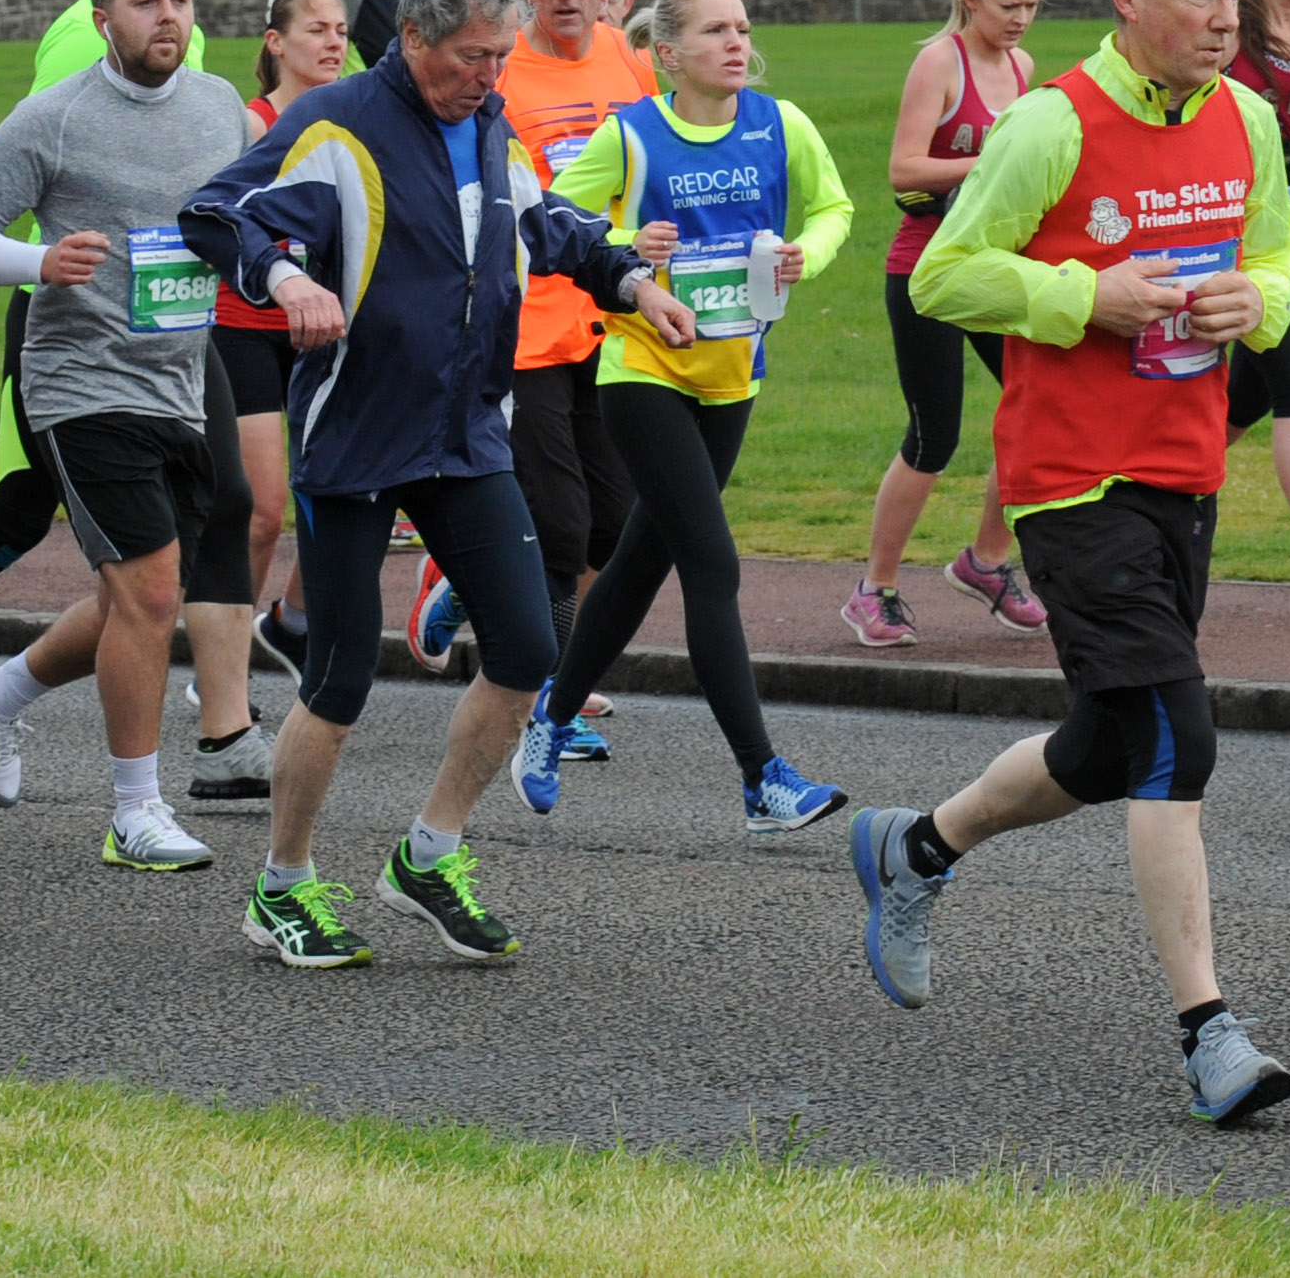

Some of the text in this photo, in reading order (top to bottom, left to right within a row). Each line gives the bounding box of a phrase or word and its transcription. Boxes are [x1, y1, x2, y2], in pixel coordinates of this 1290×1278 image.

[668, 166, 760, 196] REDCAR
[673, 188, 761, 209] RUNNING CLUB
[1135, 189, 1177, 211] The
[1179, 182, 1222, 206] Sick
[1137, 210, 1193, 229] Friends
[159, 234, 183, 243] mara
[700, 239, 745, 254] marathon
[1176, 252, 1220, 267] arathon
[689, 282, 751, 313] 1228
[1159, 309, 1191, 342] 10
